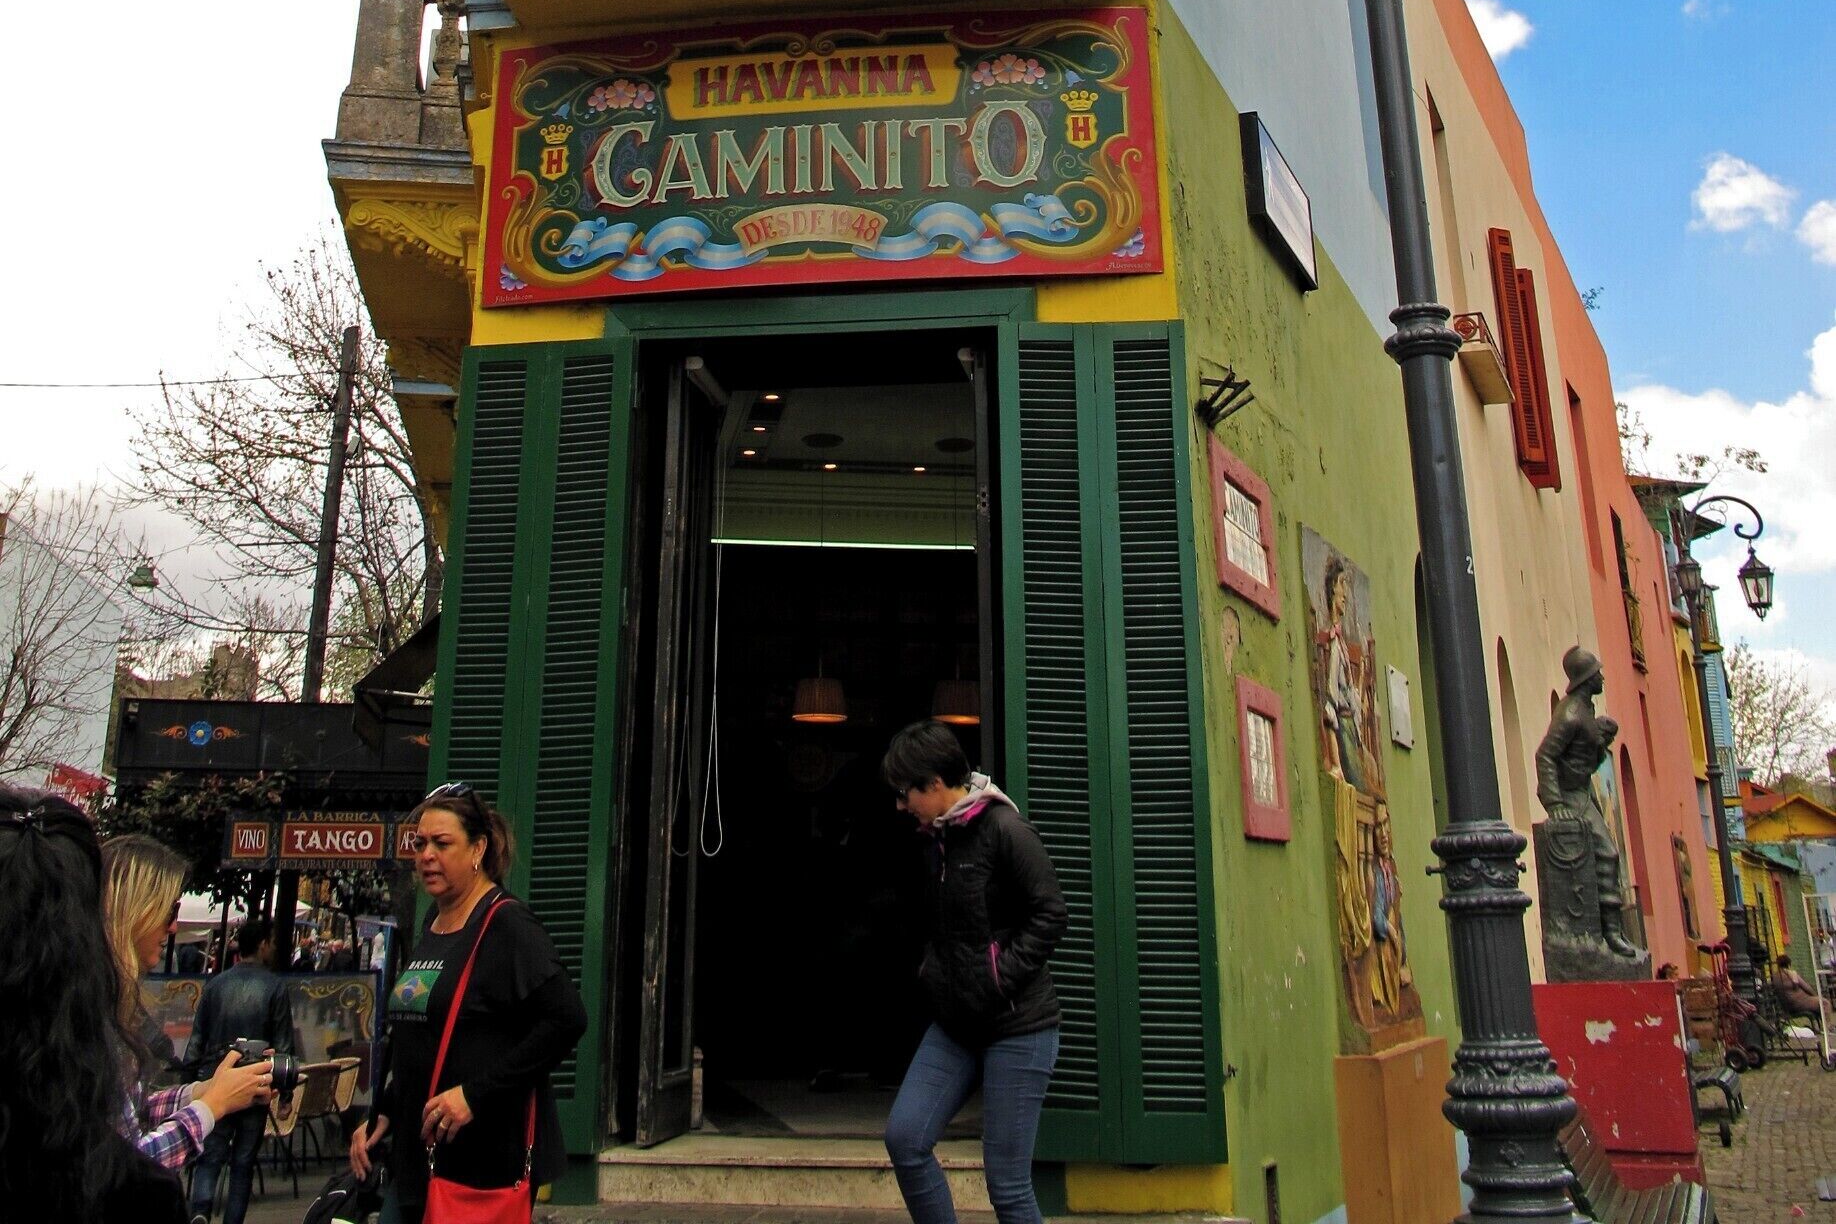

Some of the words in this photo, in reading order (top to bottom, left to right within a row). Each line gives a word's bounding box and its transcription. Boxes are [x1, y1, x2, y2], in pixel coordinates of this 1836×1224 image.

[693, 54, 936, 107] HAVANNA
[1071, 116, 1091, 141] H
[546, 149, 564, 174] H
[591, 100, 1047, 208] CAMINITO
[741, 210, 826, 246] DESDE
[831, 210, 881, 242] 1948
[287, 812, 309, 822] LA
[313, 811, 380, 822] BARRICA
[237, 829, 265, 850] VINO
[293, 829, 374, 853] TANGO
[408, 960, 444, 970] BRASIL
